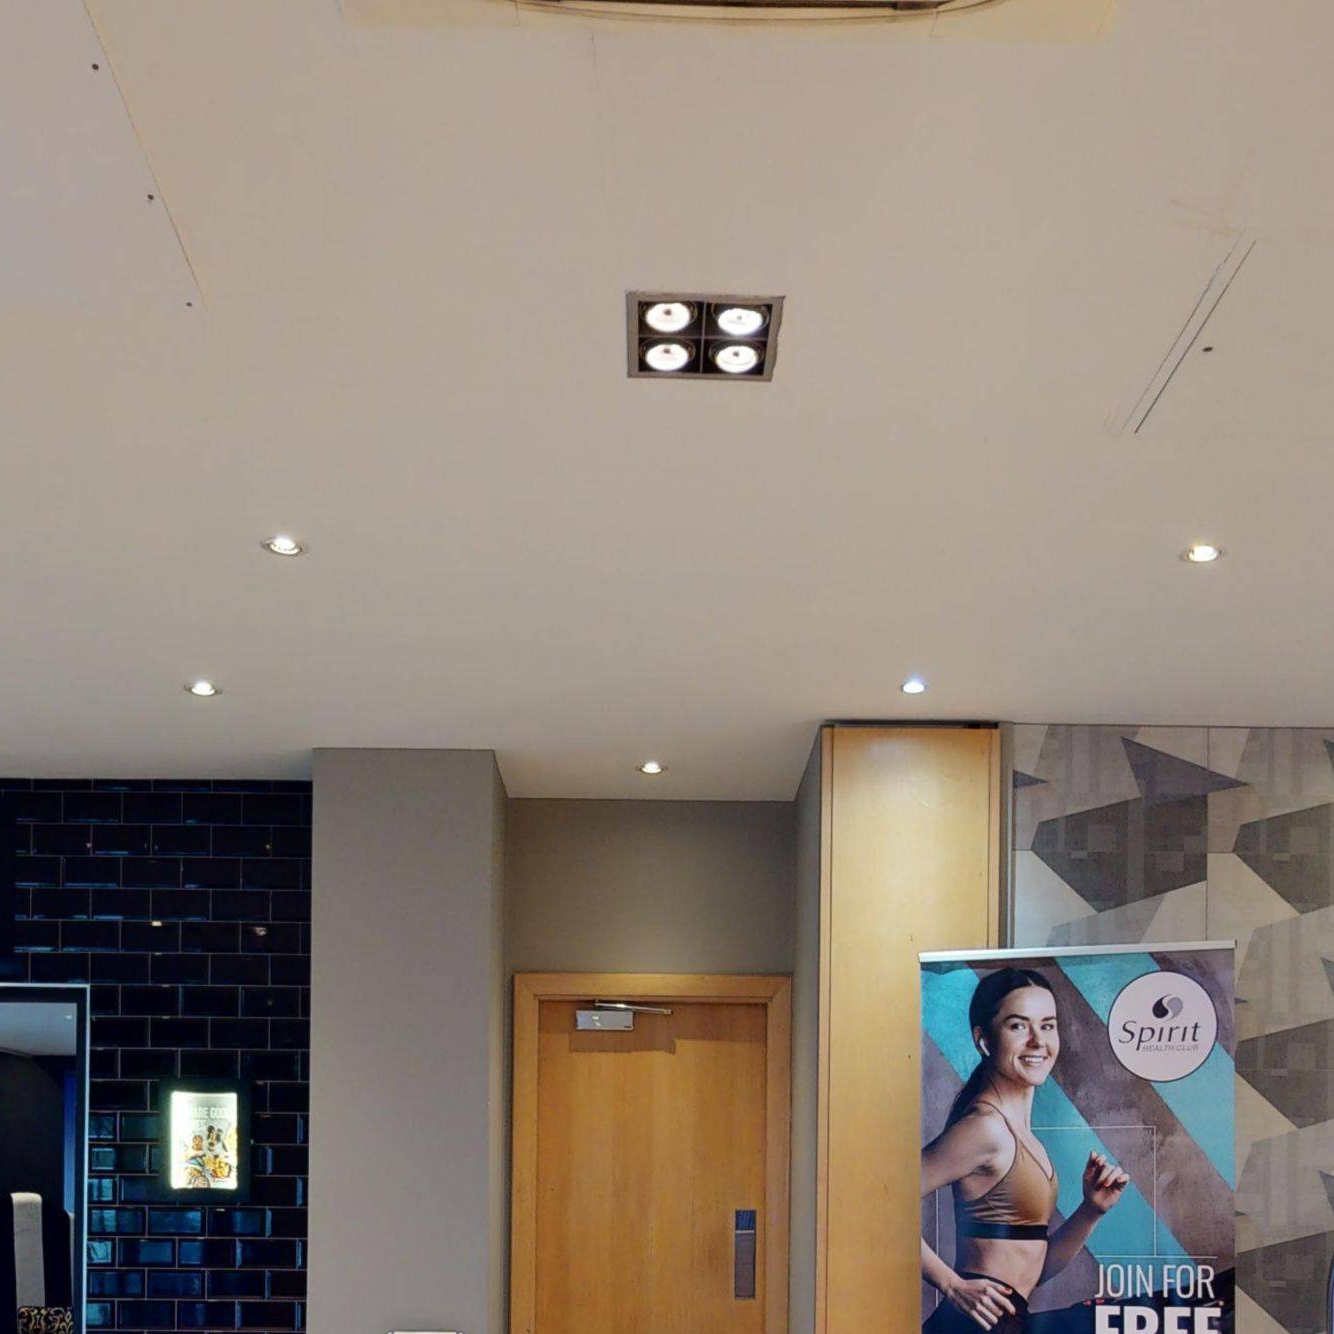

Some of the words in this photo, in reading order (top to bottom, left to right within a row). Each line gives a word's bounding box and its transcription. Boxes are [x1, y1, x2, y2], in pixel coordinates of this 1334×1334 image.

[1118, 1020, 1201, 1051] Spirit
[1094, 1263, 1154, 1299] JOIN
[1162, 1264, 1215, 1299] FOR
